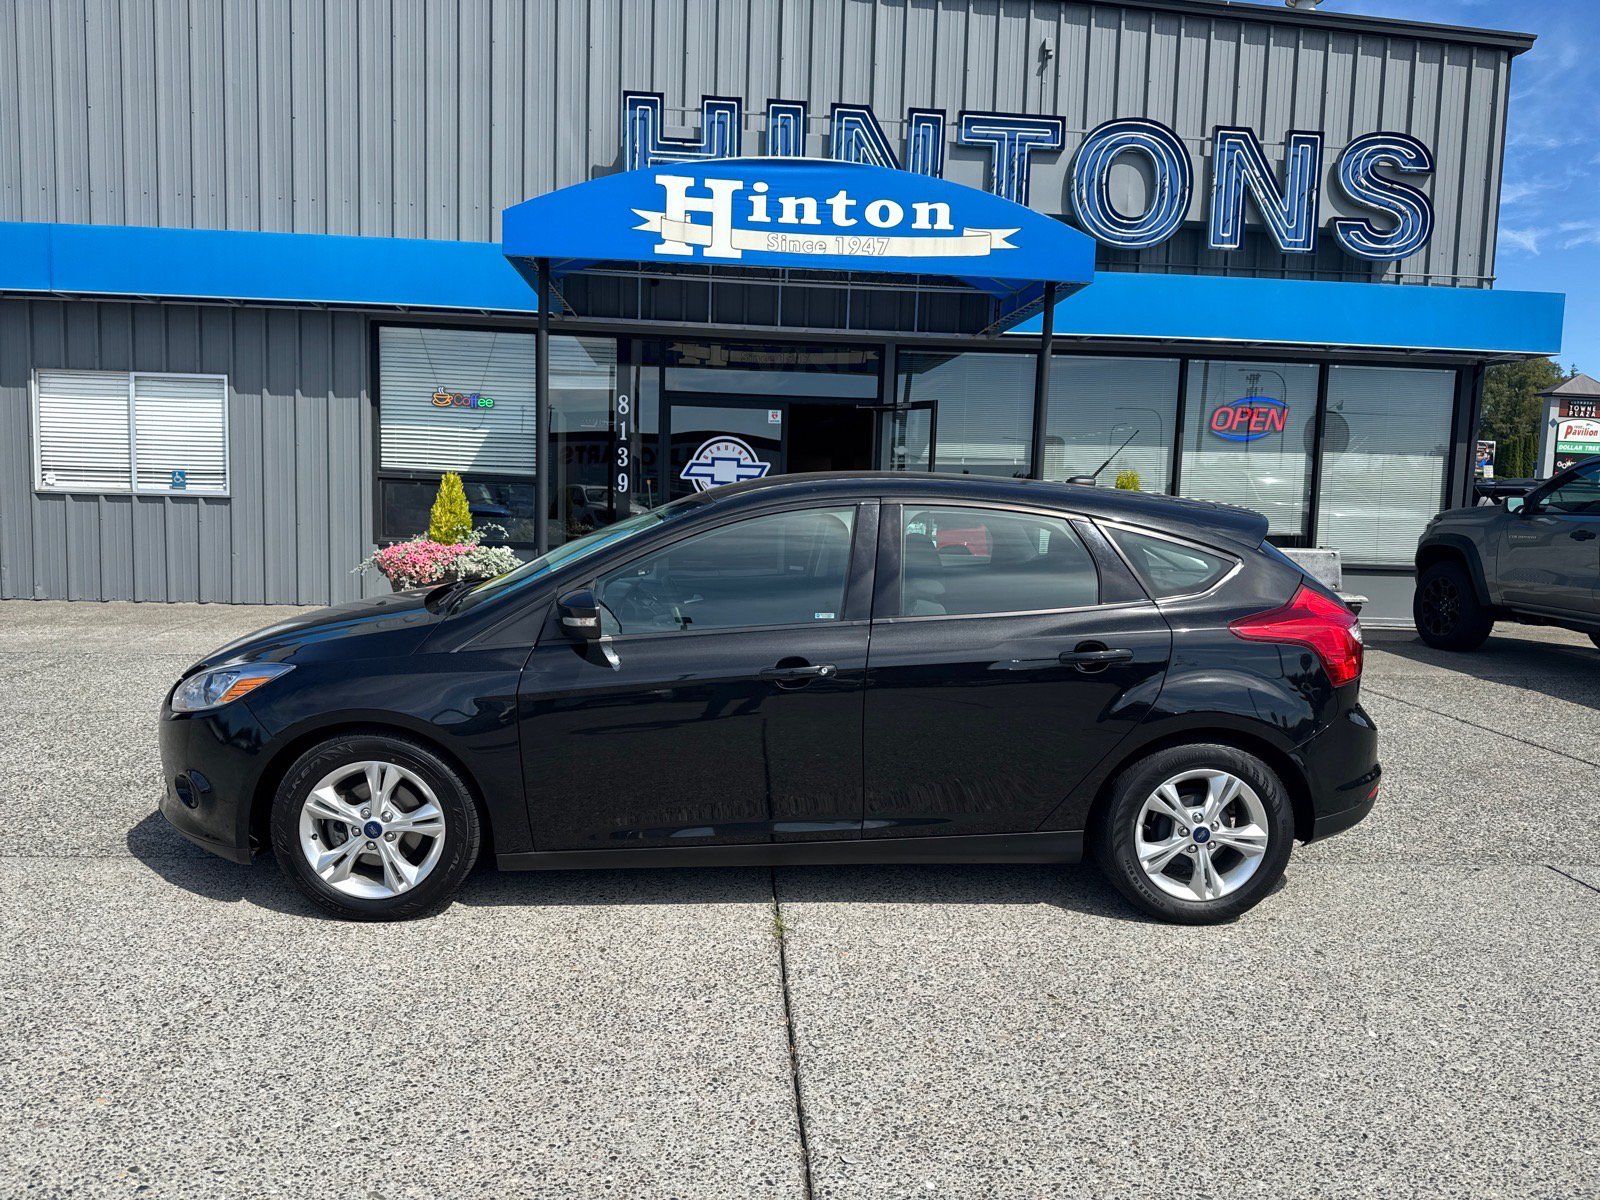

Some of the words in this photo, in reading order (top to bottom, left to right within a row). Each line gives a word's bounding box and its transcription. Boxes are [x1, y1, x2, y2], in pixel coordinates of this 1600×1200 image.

[654, 174, 955, 259] Hinton
[766, 233, 827, 254] Since
[835, 236, 890, 256] 1947
[453, 392, 494, 409] Coffee
[1211, 405, 1289, 432] OPEN
[617, 394, 630, 493] 8139
[1563, 425, 1599, 439] Pavilion
